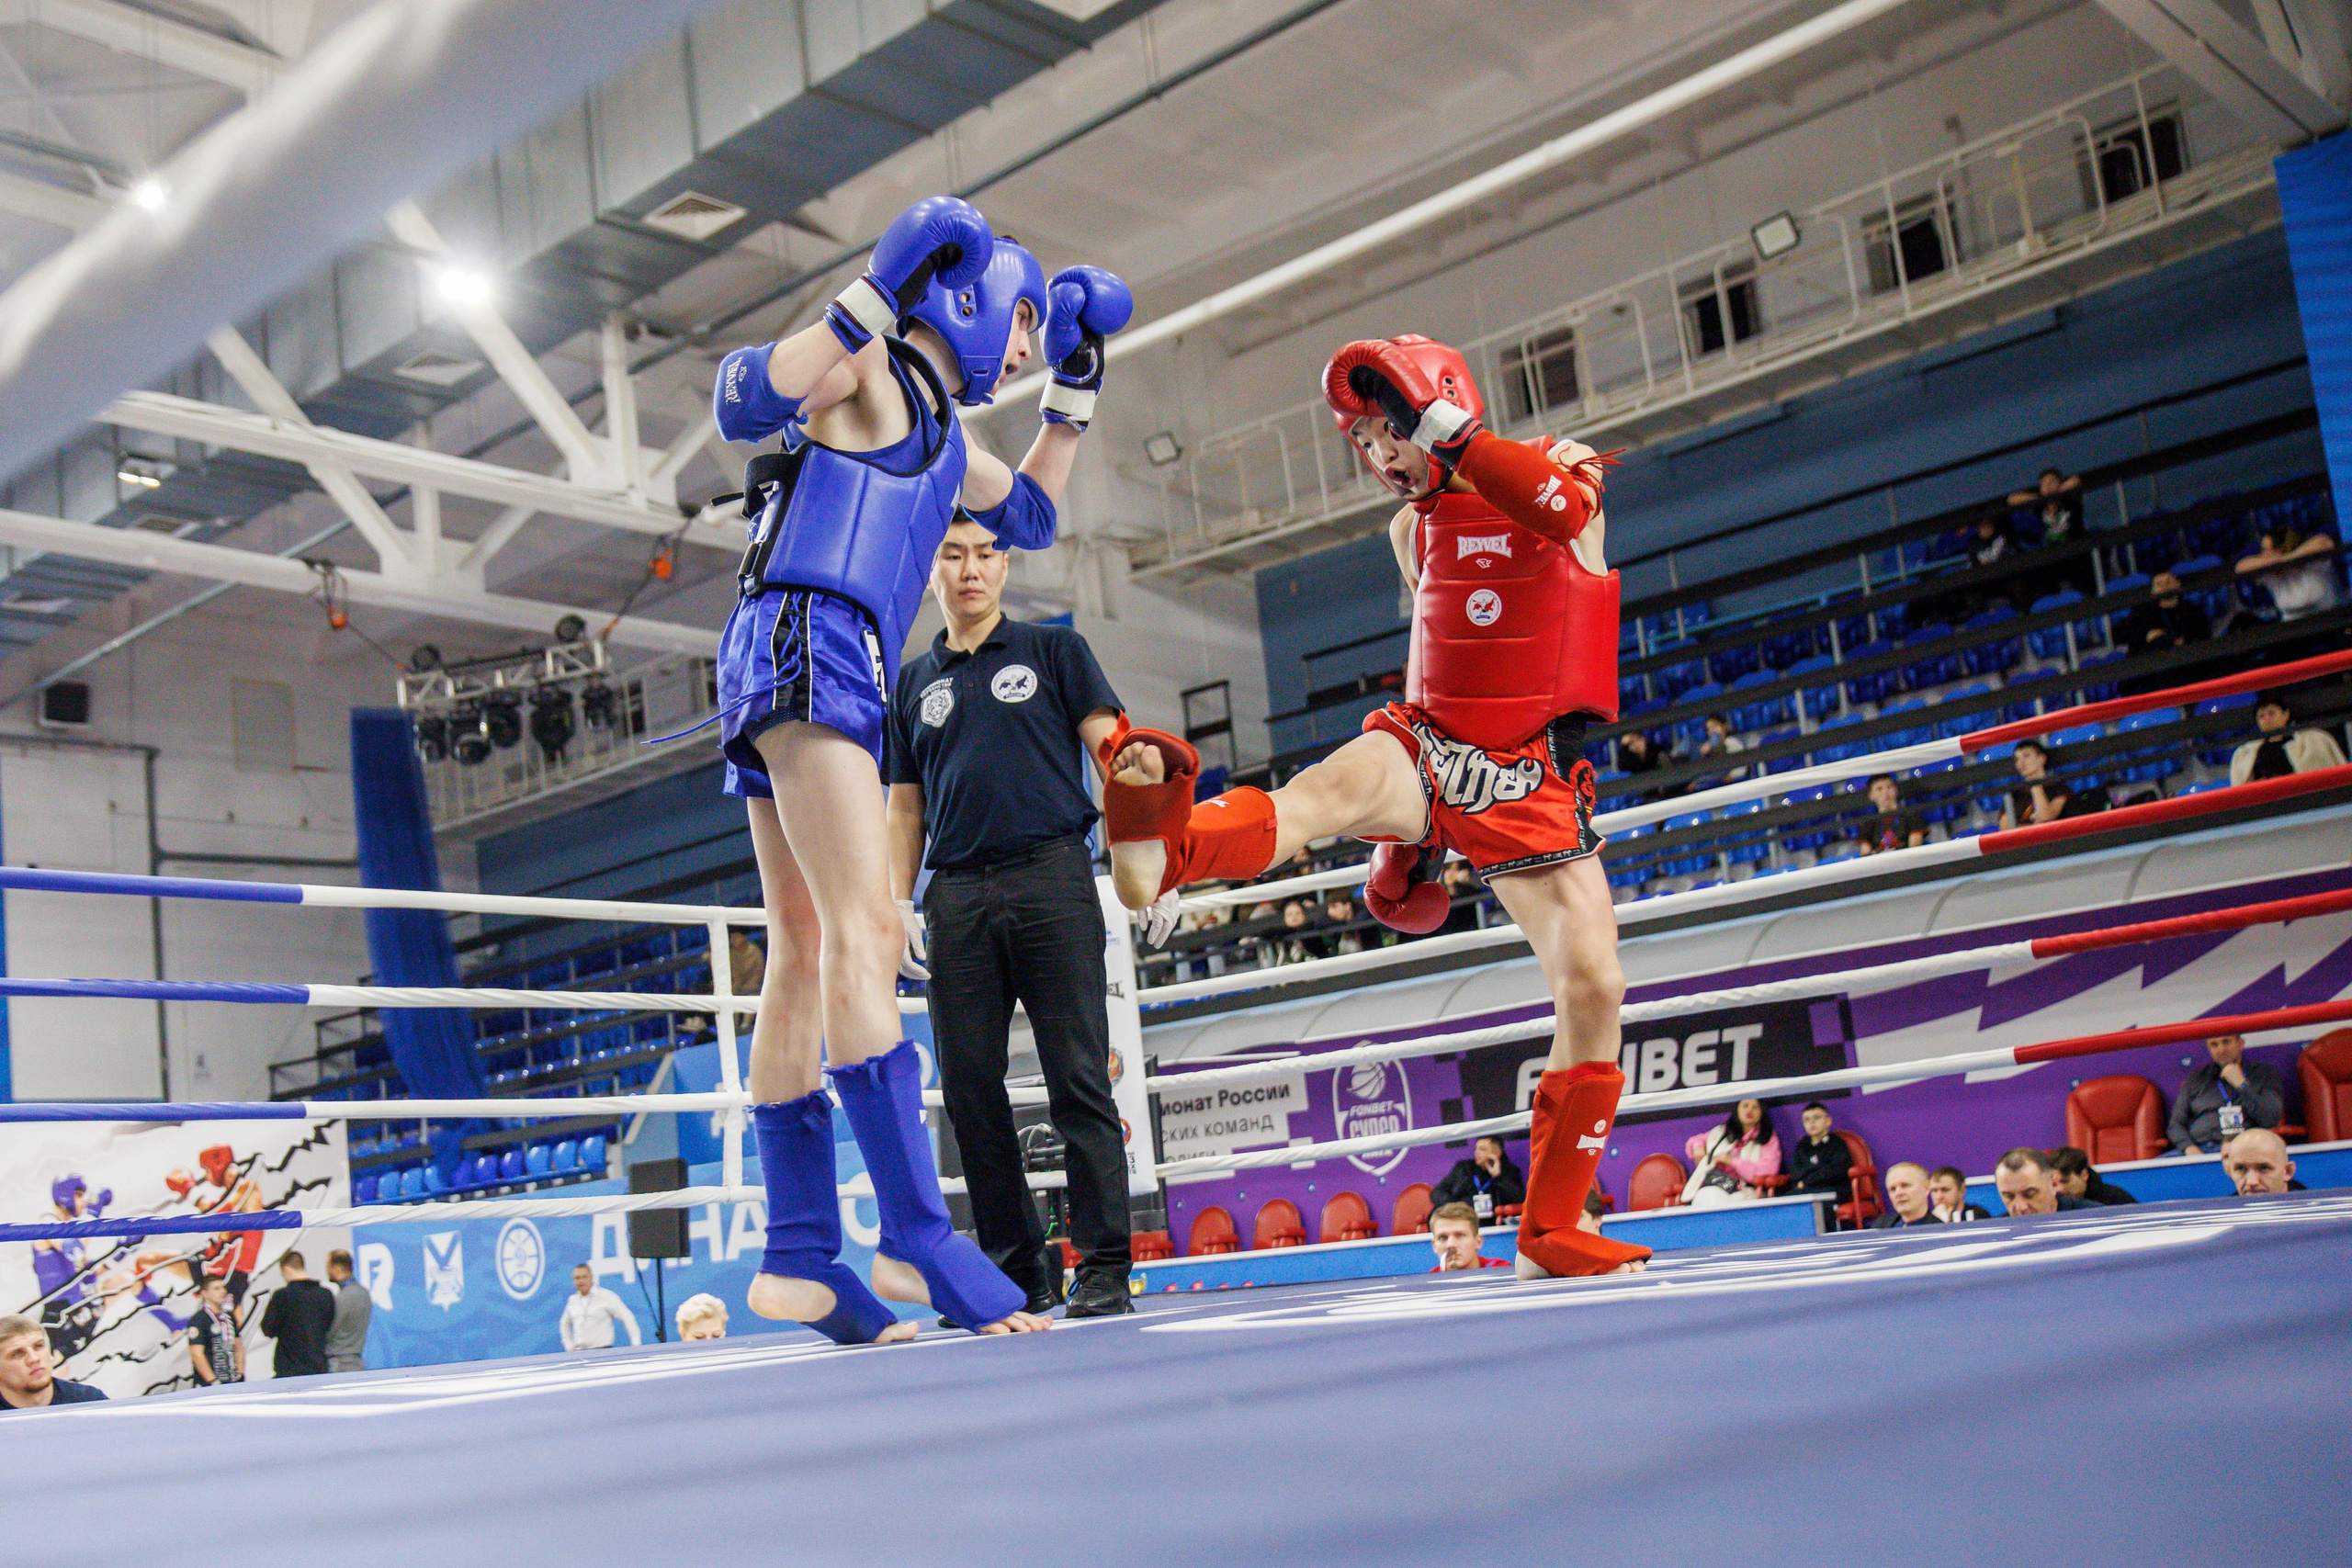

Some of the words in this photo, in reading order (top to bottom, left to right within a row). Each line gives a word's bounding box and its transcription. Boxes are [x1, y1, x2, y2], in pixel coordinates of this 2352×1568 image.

[1457, 534, 1512, 560] REYVEL
[1515, 1022, 1764, 1111] FBET
[1160, 1095, 1214, 1116] ионат
[1217, 1084, 1290, 1108] России
[1162, 1125, 1199, 1144] ских
[1204, 1114, 1274, 1136] команд
